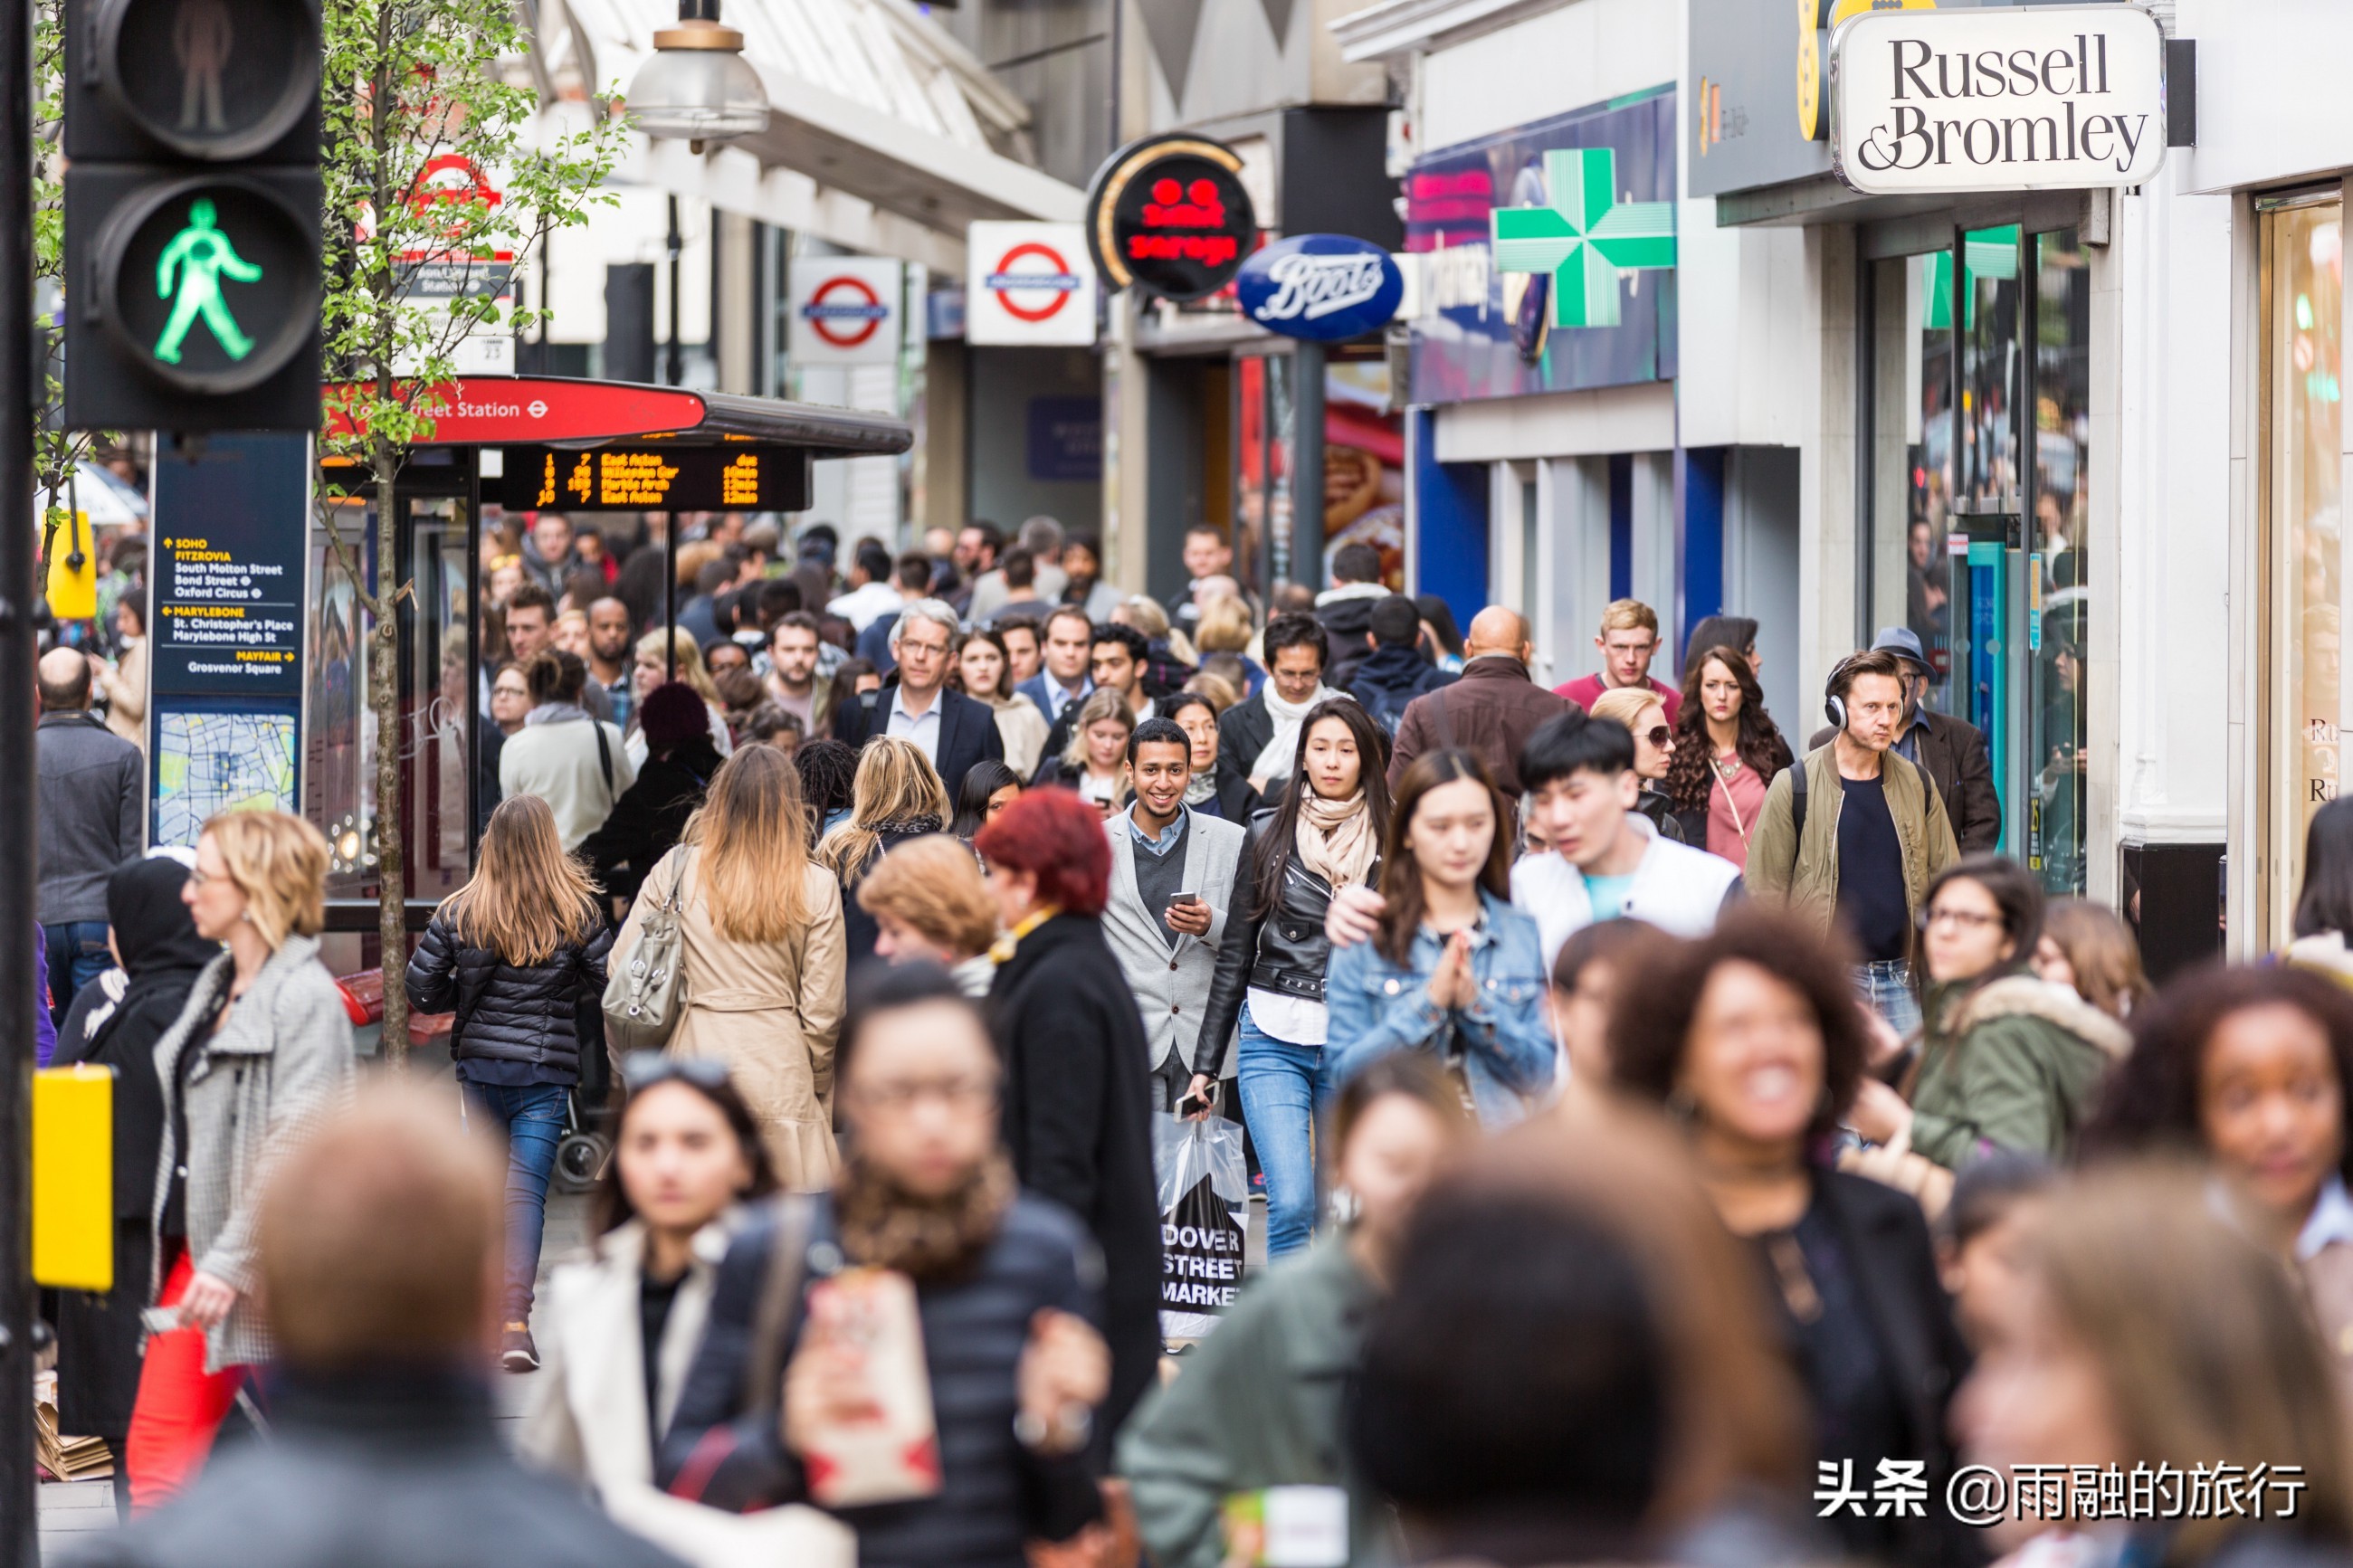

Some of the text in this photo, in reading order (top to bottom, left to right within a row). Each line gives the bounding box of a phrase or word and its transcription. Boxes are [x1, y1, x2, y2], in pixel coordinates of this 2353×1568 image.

[1888, 33, 2110, 100] Russell
[1254, 252, 1384, 320] Boots
[457, 402, 519, 417] Station
[546, 453, 553, 466] 1
[581, 453, 591, 466] 7
[601, 453, 628, 466] East
[641, 478, 670, 490] Arch
[601, 489, 628, 503] East
[176, 538, 207, 549] SOHO
[175, 551, 231, 562] FITZROVIA
[175, 562, 282, 575] South Molton Street
[175, 575, 238, 586] Bond Street
[175, 587, 248, 598] Oxford Circus
[174, 606, 244, 618] MARYLEBONE
[174, 618, 294, 632] St. Christopher's Place
[174, 630, 276, 644] Marylebone High St
[236, 651, 281, 661] MAYFAIR
[187, 661, 281, 676] Grosvenor Square
[1161, 1223, 1240, 1251] DOVER
